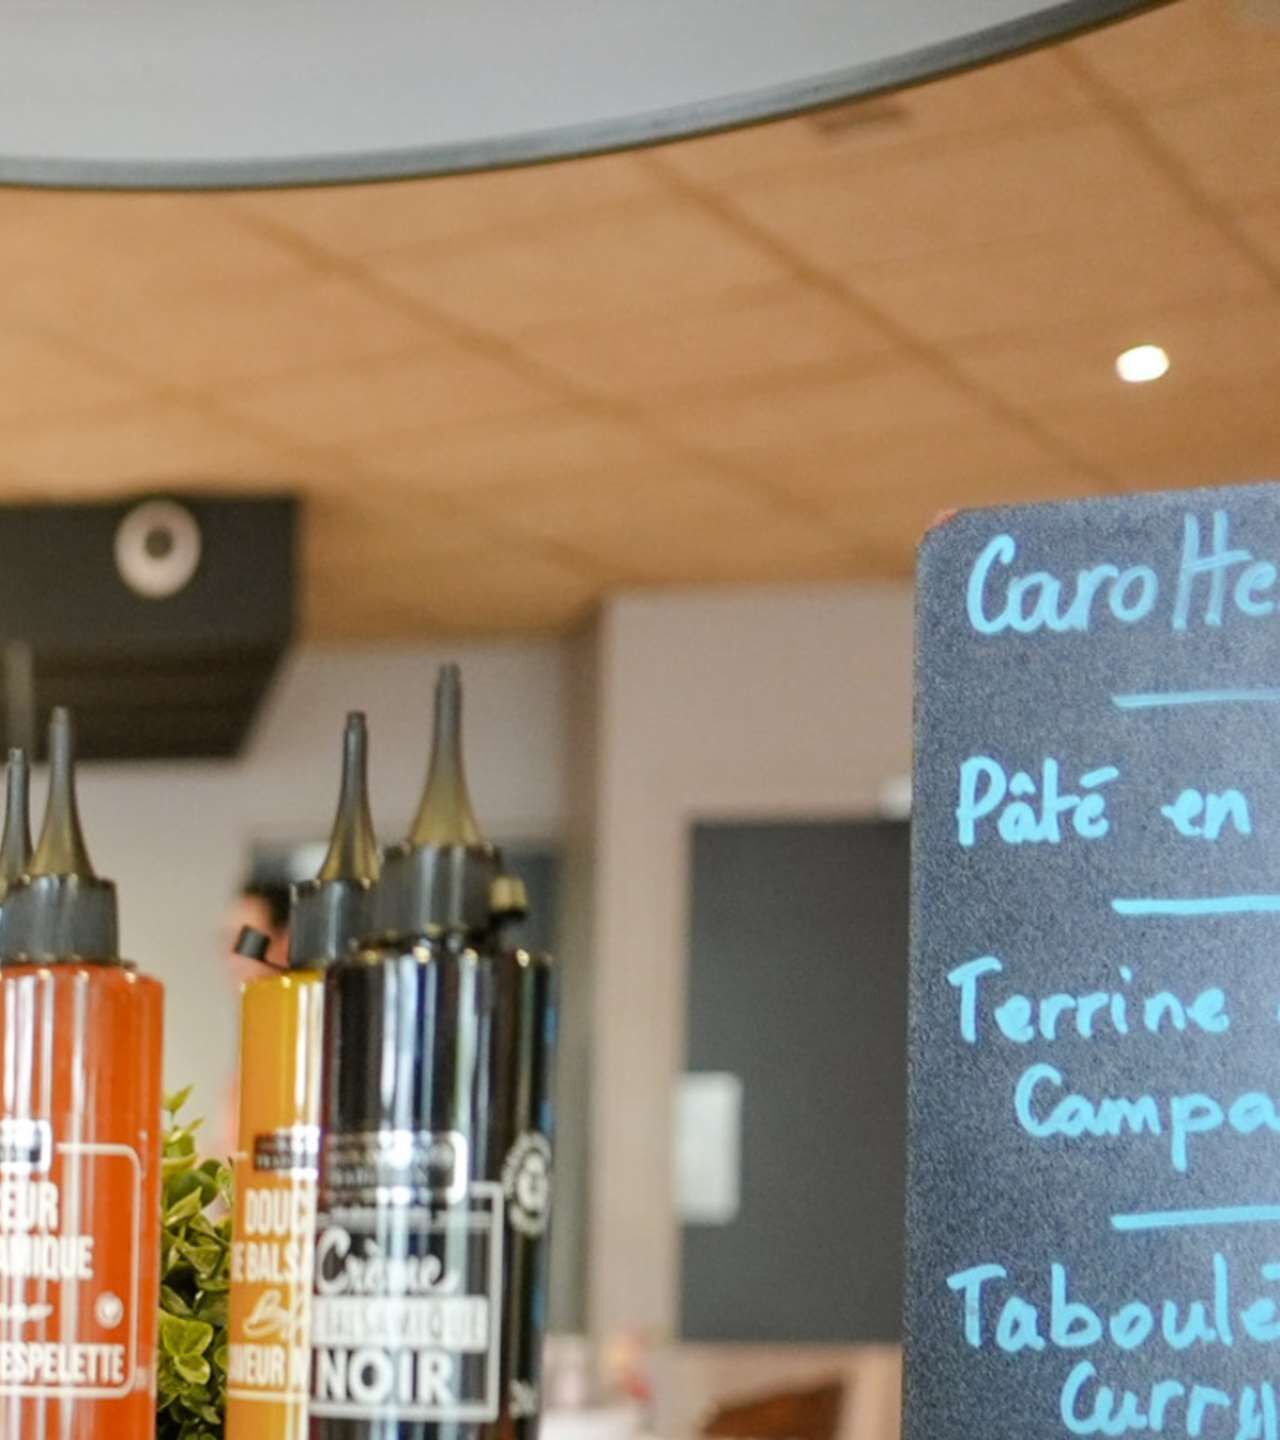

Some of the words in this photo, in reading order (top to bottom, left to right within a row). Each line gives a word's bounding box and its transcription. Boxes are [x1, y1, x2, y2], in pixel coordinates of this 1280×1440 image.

[956, 756, 1119, 847] Pâté
[1162, 789, 1251, 841] en
[947, 956, 1229, 1042] Terrine
[1015, 1063, 1280, 1172] Campa
[319, 1349, 454, 1405] NOIR
